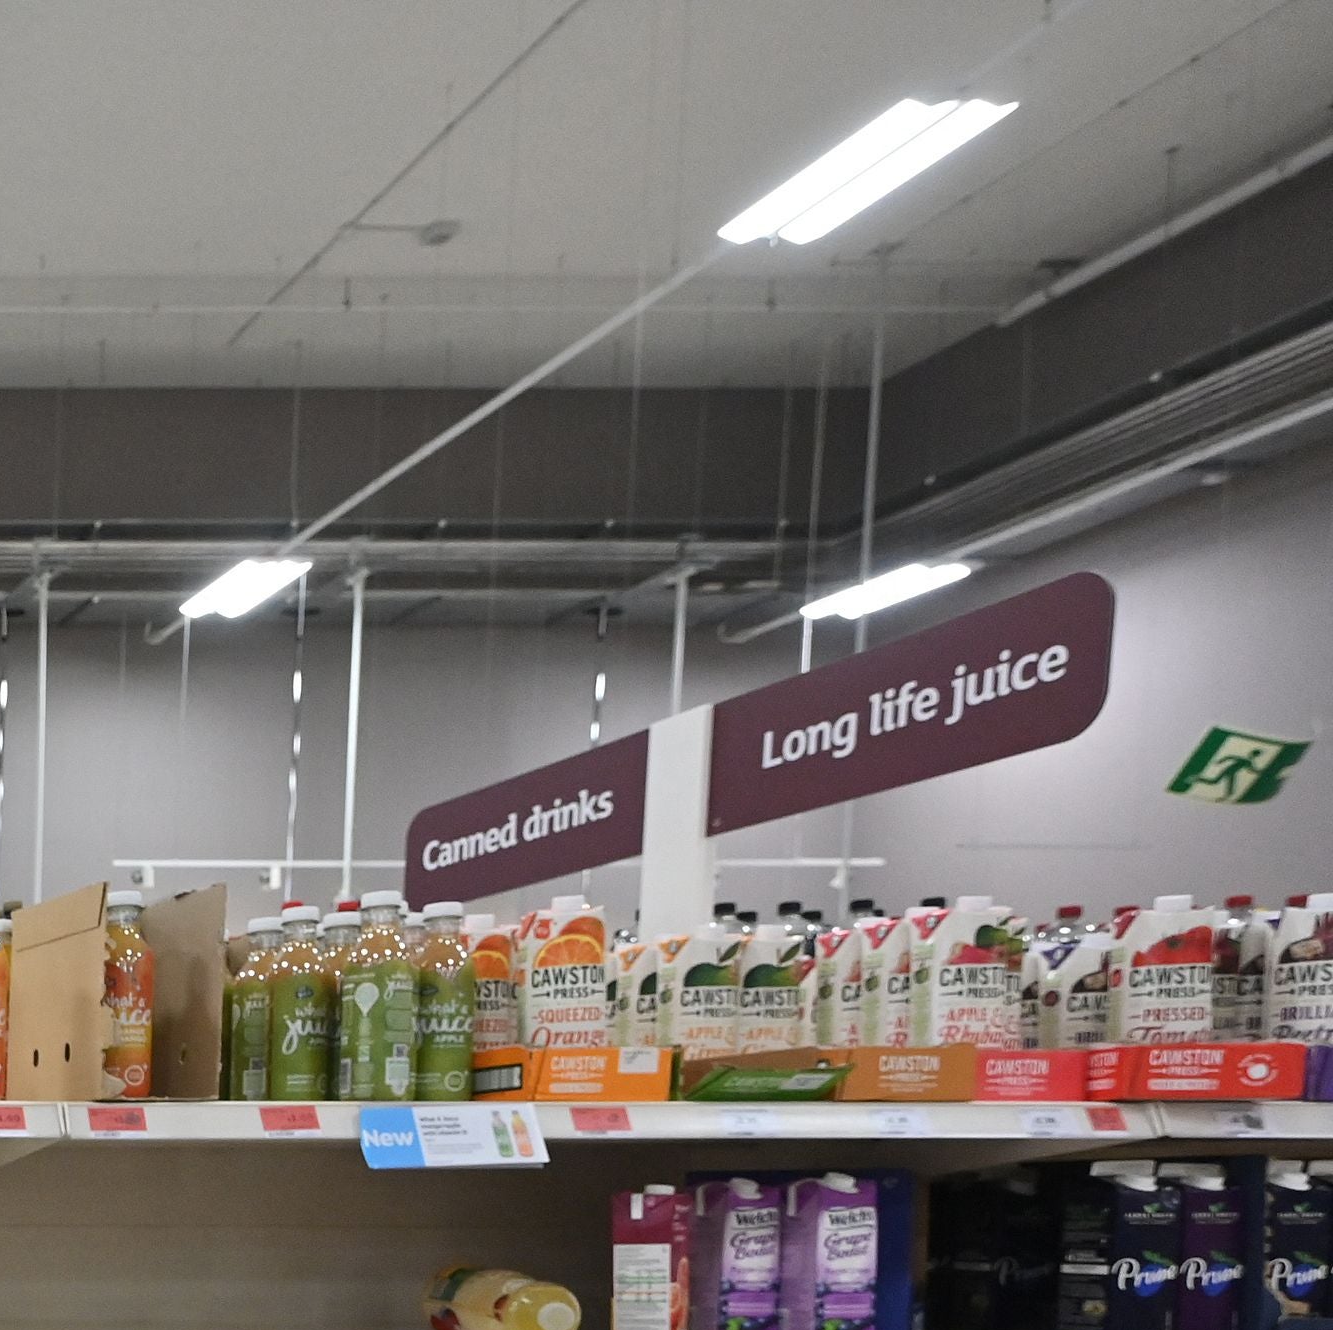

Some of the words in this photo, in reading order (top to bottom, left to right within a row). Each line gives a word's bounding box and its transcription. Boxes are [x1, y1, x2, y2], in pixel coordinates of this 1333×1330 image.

[760, 711, 859, 769] Long
[867, 677, 938, 737] life
[942, 642, 1070, 726] juice
[421, 811, 519, 871] Canned
[522, 787, 614, 843] drinks
[531, 964, 605, 989] CAWSTON
[553, 987, 589, 999] PRESS
[1148, 1049, 1226, 1066] CAWSTON
[362, 1127, 414, 1148] New
[1111, 1256, 1179, 1291] Prune
[1179, 1256, 1244, 1291] Prune
[1268, 1257, 1328, 1292] Prune
